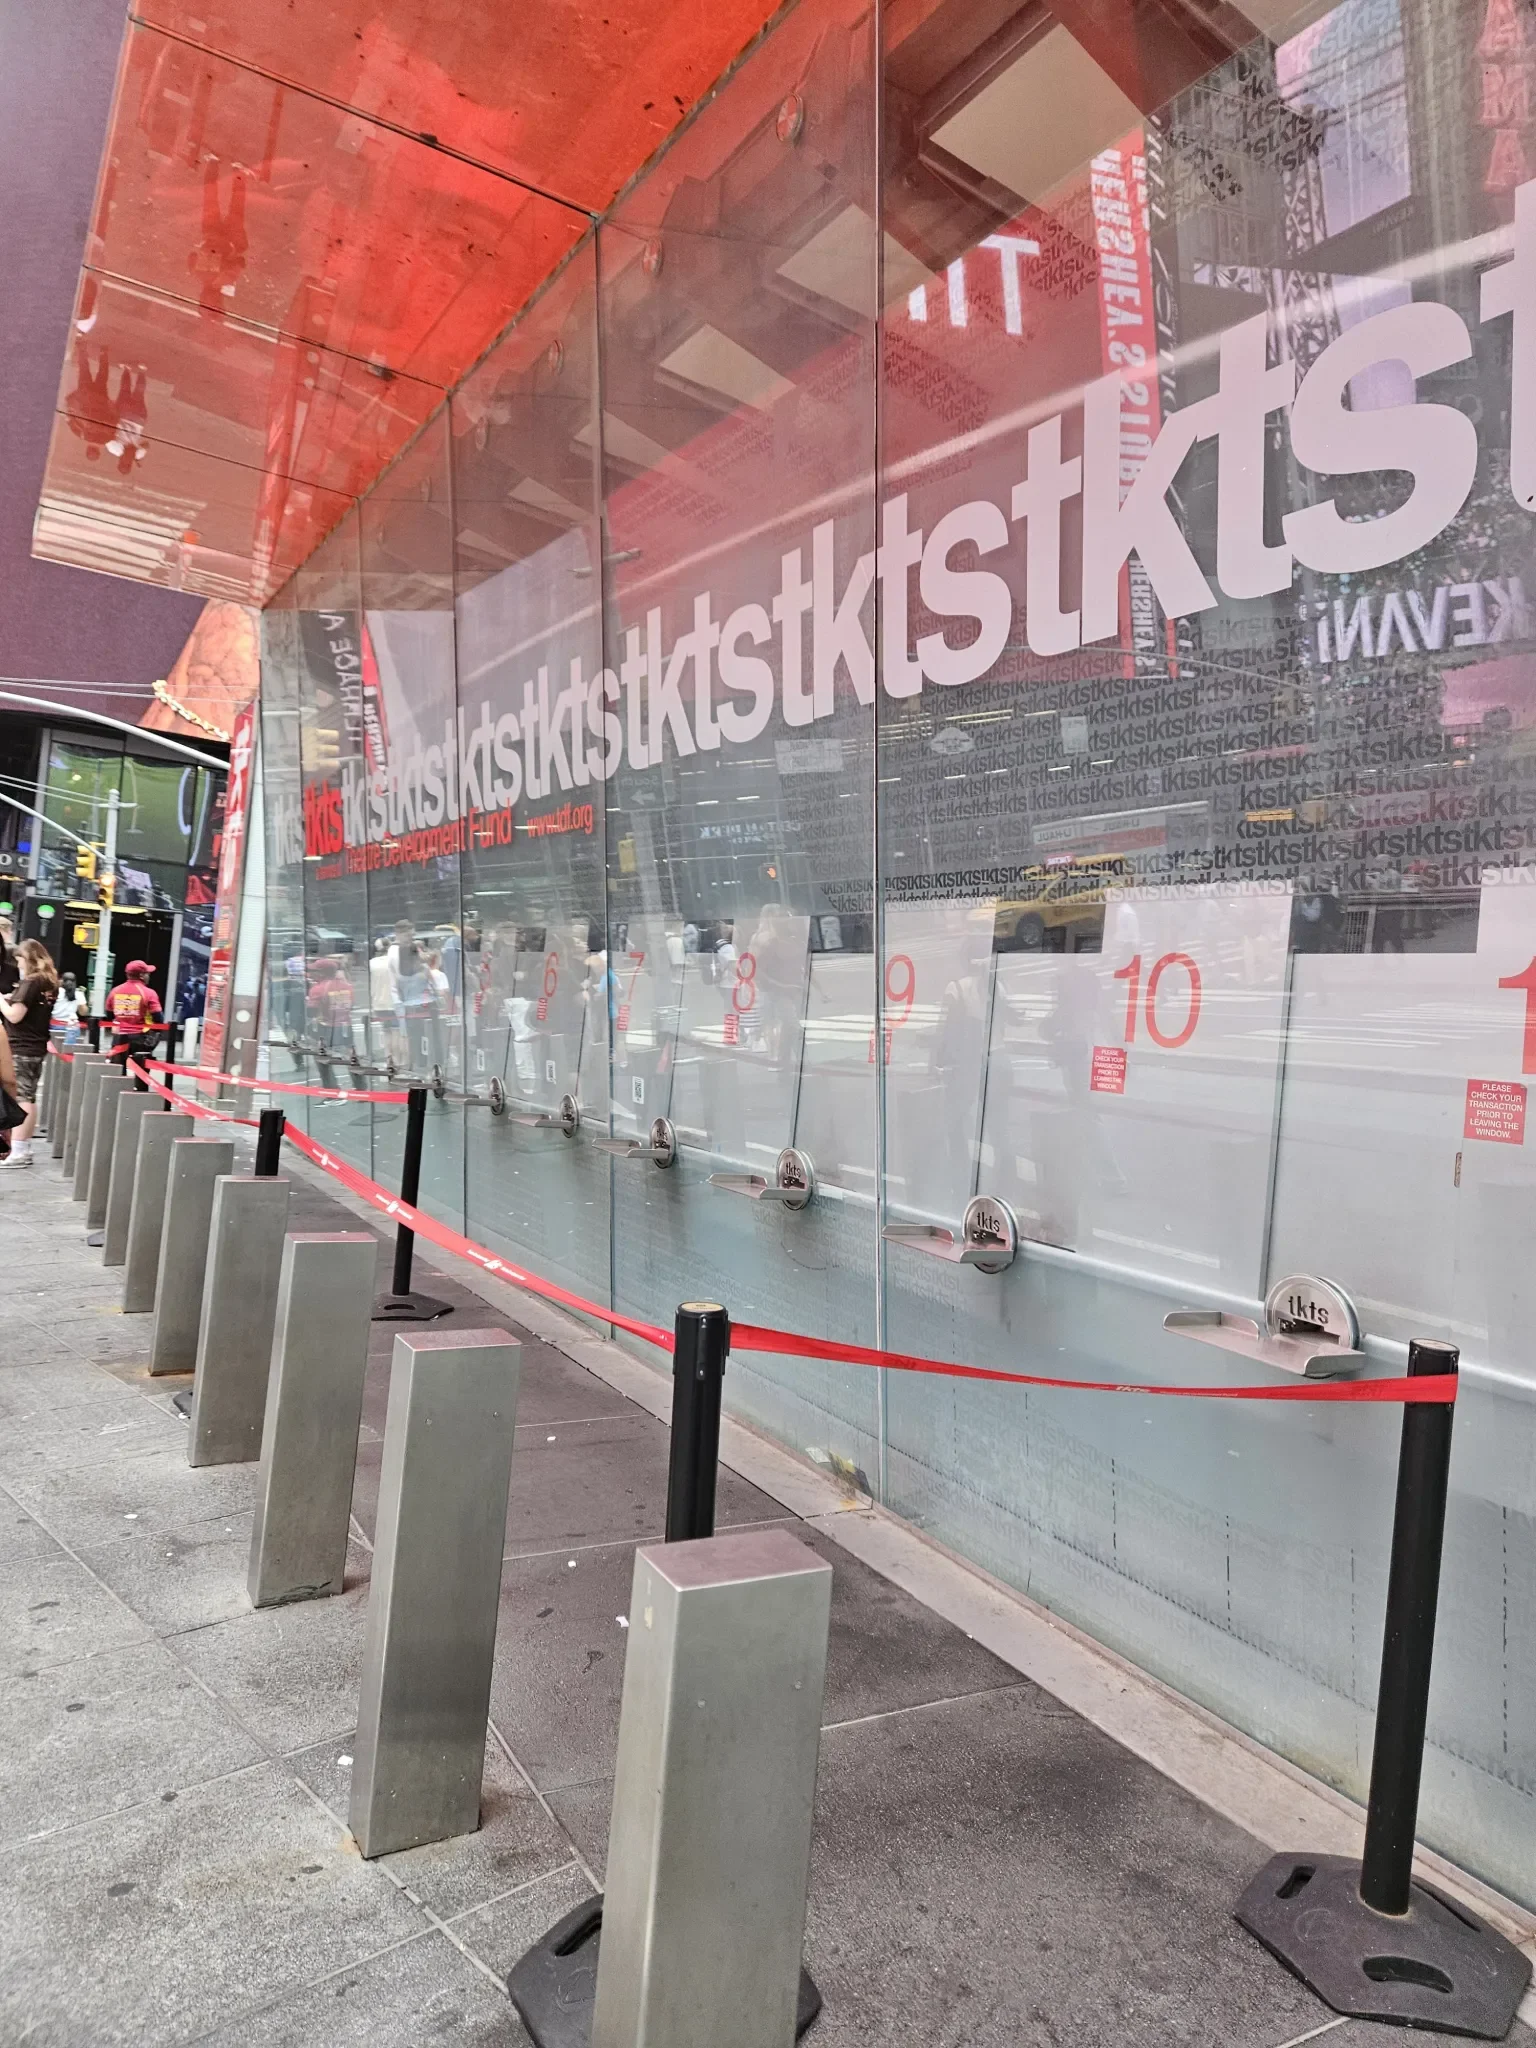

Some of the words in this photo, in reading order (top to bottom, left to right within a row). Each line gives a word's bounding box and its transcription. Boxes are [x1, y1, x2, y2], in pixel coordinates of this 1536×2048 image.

[384, 812, 466, 869] Development
[469, 797, 512, 851] Fund
[526, 803, 594, 839] www.tdf.org
[544, 952, 559, 998] 6
[628, 952, 646, 1001] 7
[732, 954, 756, 1014] 8
[885, 953, 916, 1029] 9
[1113, 952, 1201, 1049] 10
[1471, 1091, 1498, 1100] CHECK
[1499, 1094, 1522, 1102] YOUR
[1482, 1083, 1512, 1092] PLEASE
[1469, 1100, 1523, 1112] TRANSACTION
[1476, 1110, 1501, 1119] PRIOR
[1502, 1112, 1514, 1120] TO
[1469, 1118, 1502, 1128] LEAVING
[1503, 1121, 1520, 1130] THE
[1475, 1128, 1512, 1139] WINDOW.
[785, 1161, 801, 1178] tkts
[976, 1211, 1000, 1233] tkts
[1288, 1295, 1329, 1325] tkts
